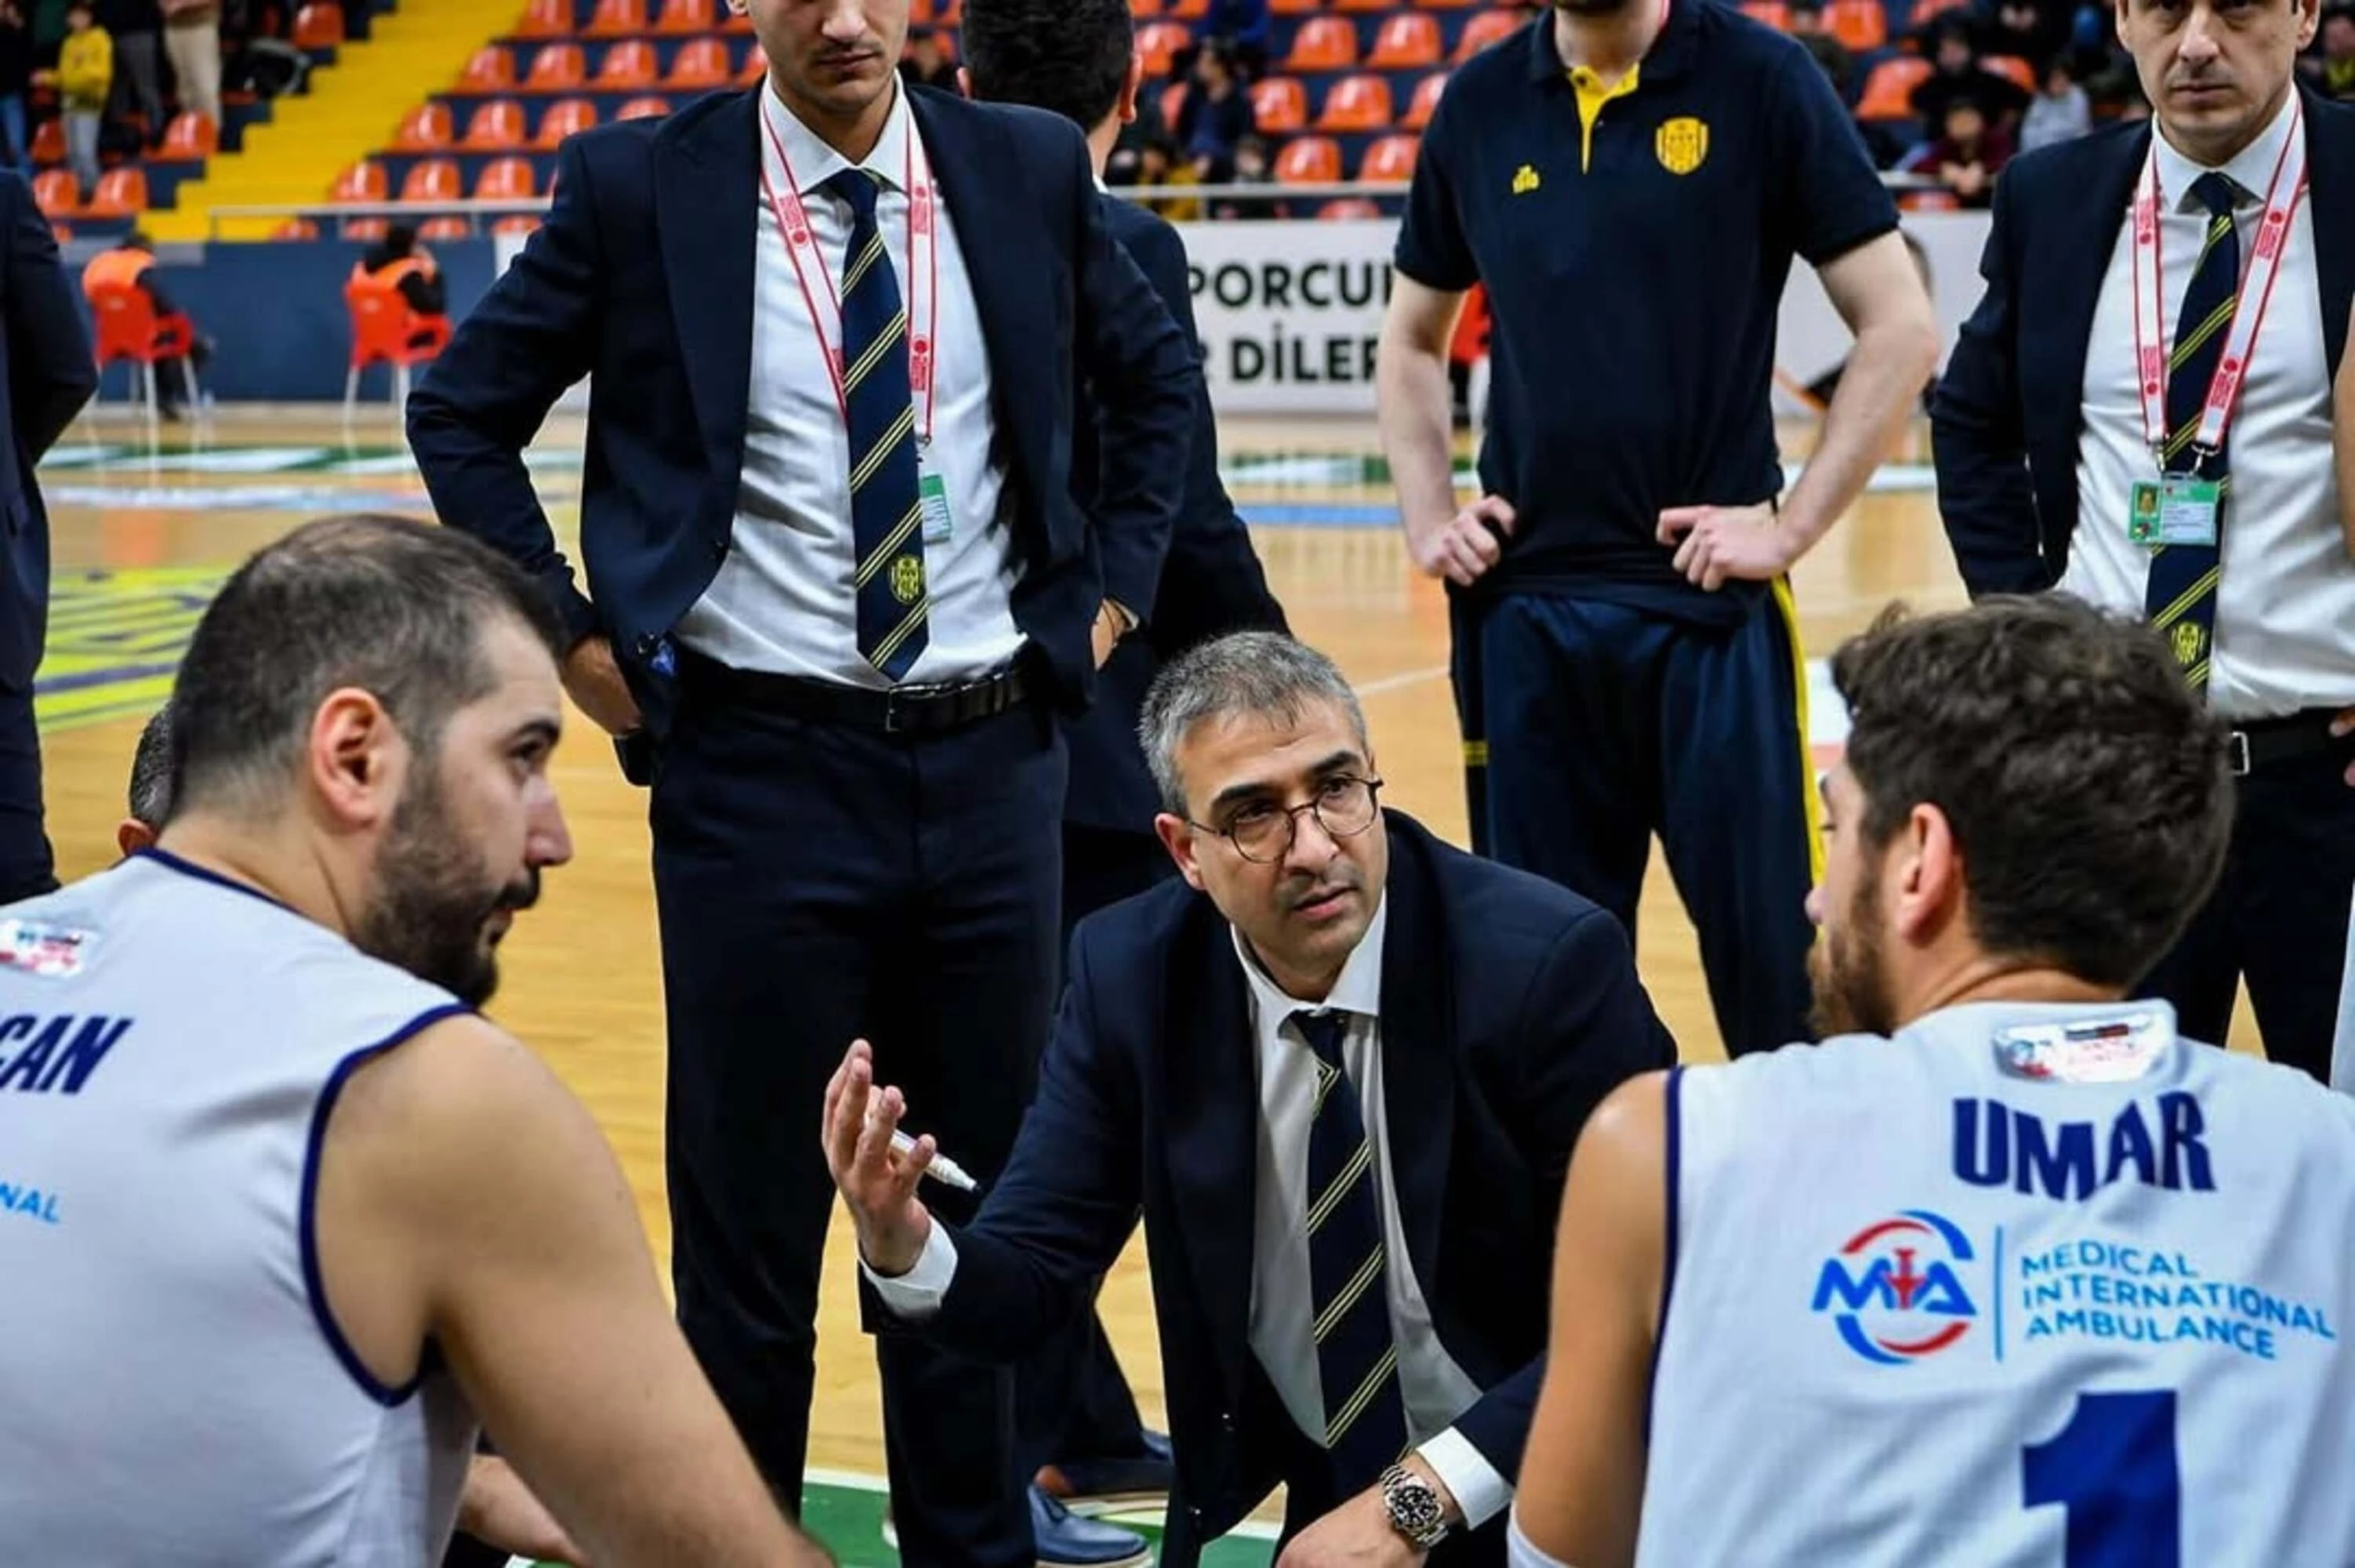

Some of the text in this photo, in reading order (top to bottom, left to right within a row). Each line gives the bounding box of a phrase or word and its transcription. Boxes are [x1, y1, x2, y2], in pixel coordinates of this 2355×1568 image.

[1952, 1090, 2217, 1201] UMAR
[2020, 1240, 2199, 1279] MEDICAL
[2021, 1272, 2337, 1340] INTERNATIONAL
[2026, 1308, 2277, 1360] AMBULANCE
[2021, 1388, 2183, 1568] 1
